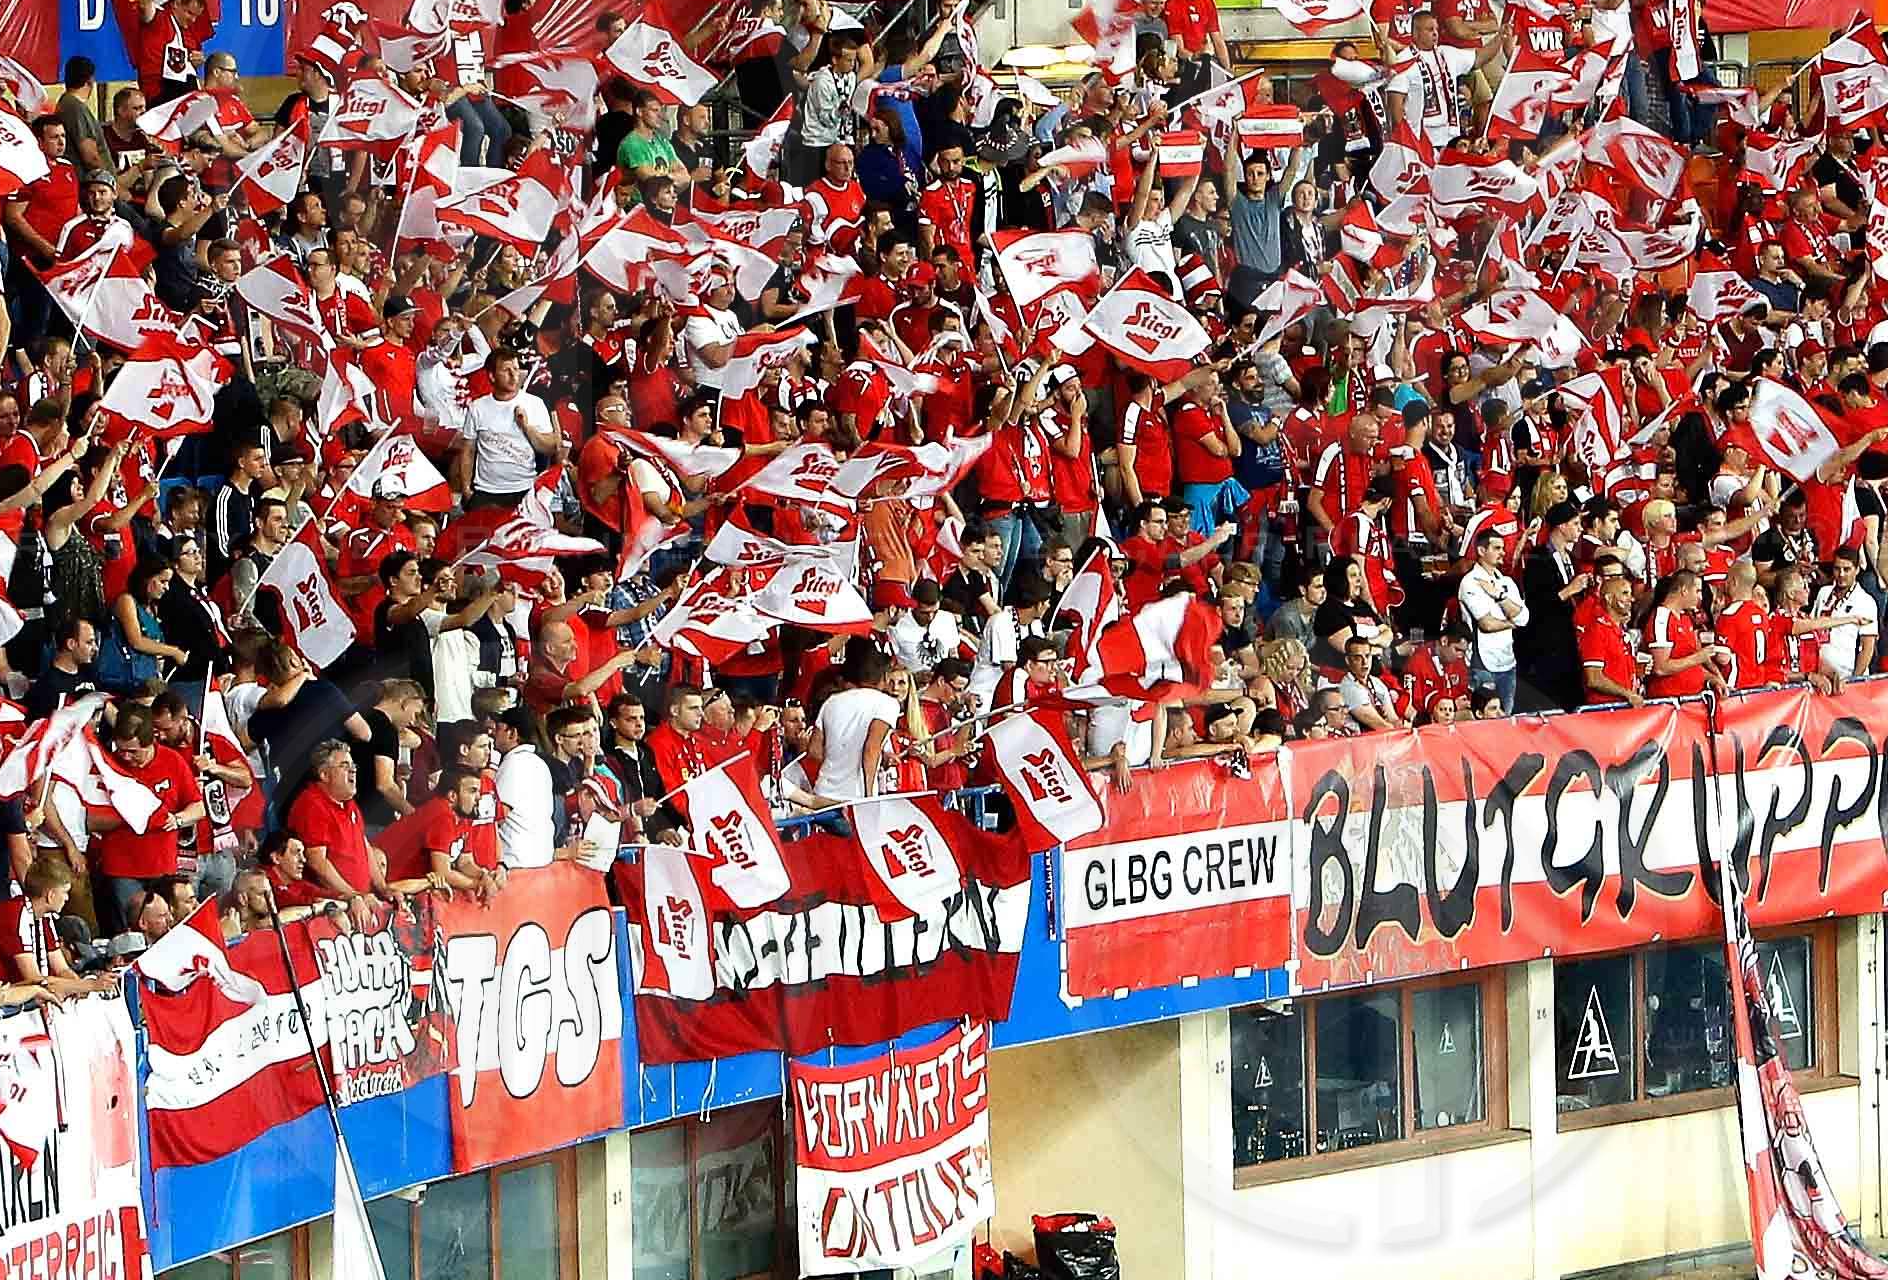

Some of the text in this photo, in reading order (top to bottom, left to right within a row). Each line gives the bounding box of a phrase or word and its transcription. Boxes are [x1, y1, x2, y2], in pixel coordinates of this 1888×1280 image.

[1528, 32, 1563, 51] WIR
[341, 90, 386, 115] Stiegl
[1123, 301, 1182, 340] Stiegl
[296, 573, 327, 629] Stiegl
[791, 567, 843, 594] Stiegl
[1021, 748, 1073, 803] Stiegl
[711, 809, 760, 872] Stiegl
[892, 823, 936, 879] Stiegl
[1084, 851, 1173, 911] GLBG
[1182, 834, 1277, 896] CREW
[665, 895, 691, 961] Stiegl
[448, 908, 612, 1108] TGS
[797, 1022, 986, 1159] VORWÄRTS
